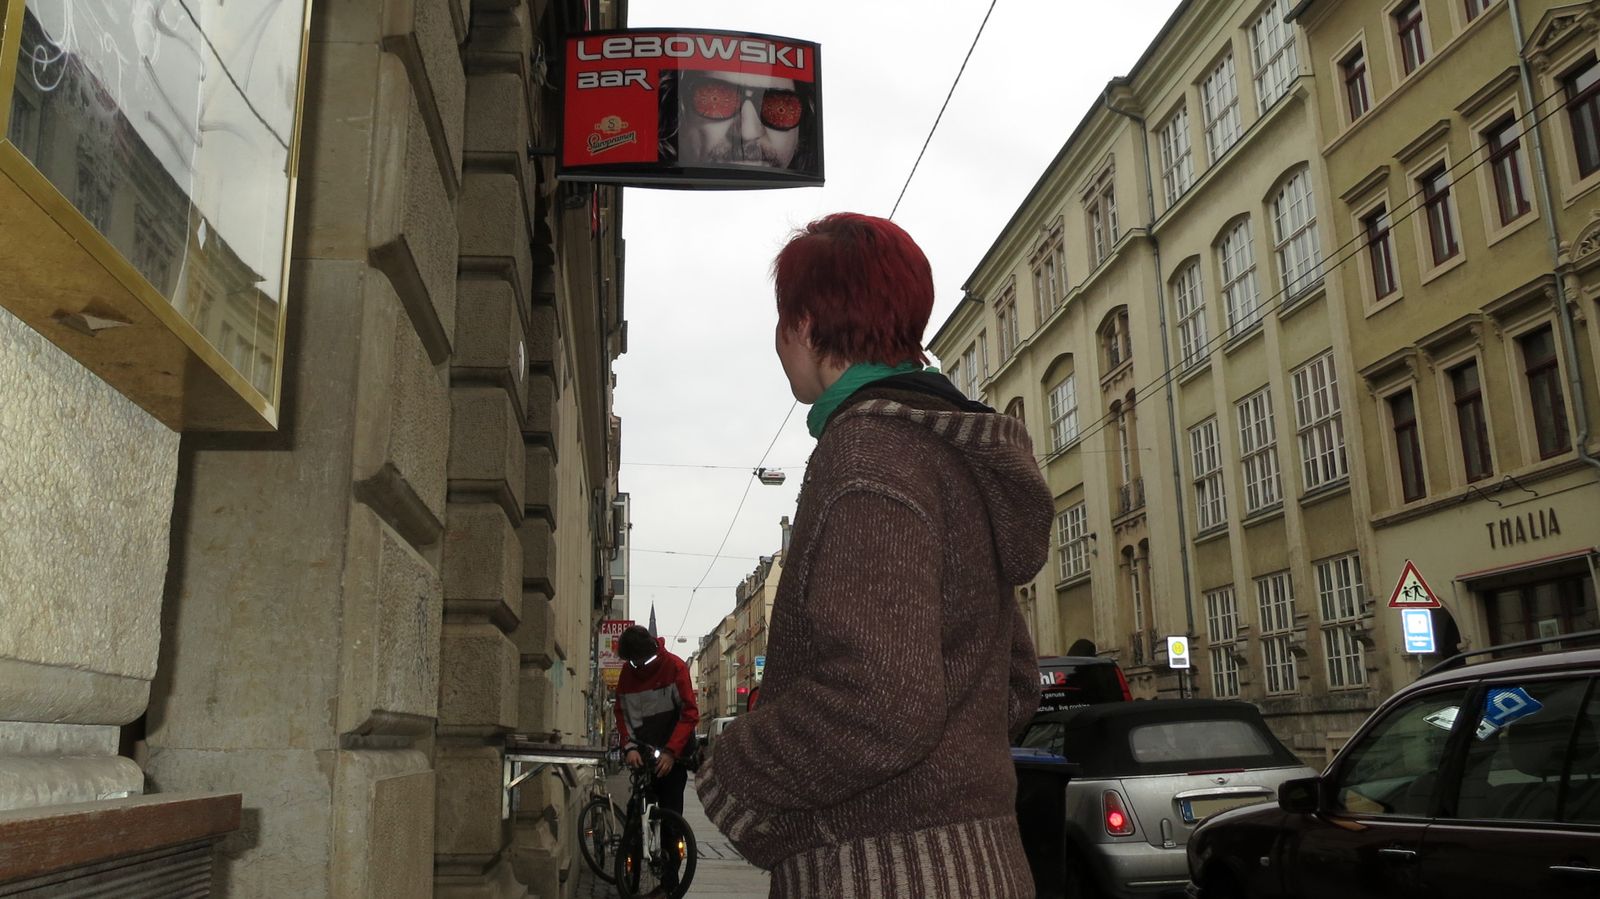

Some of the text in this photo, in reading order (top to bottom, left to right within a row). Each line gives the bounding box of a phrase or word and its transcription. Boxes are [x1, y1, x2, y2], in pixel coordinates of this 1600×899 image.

[588, 132, 636, 154] Staropramen
[1485, 507, 1562, 549] THALIA
[601, 623, 634, 635] FARBE
[1039, 671, 1067, 685] hl2
